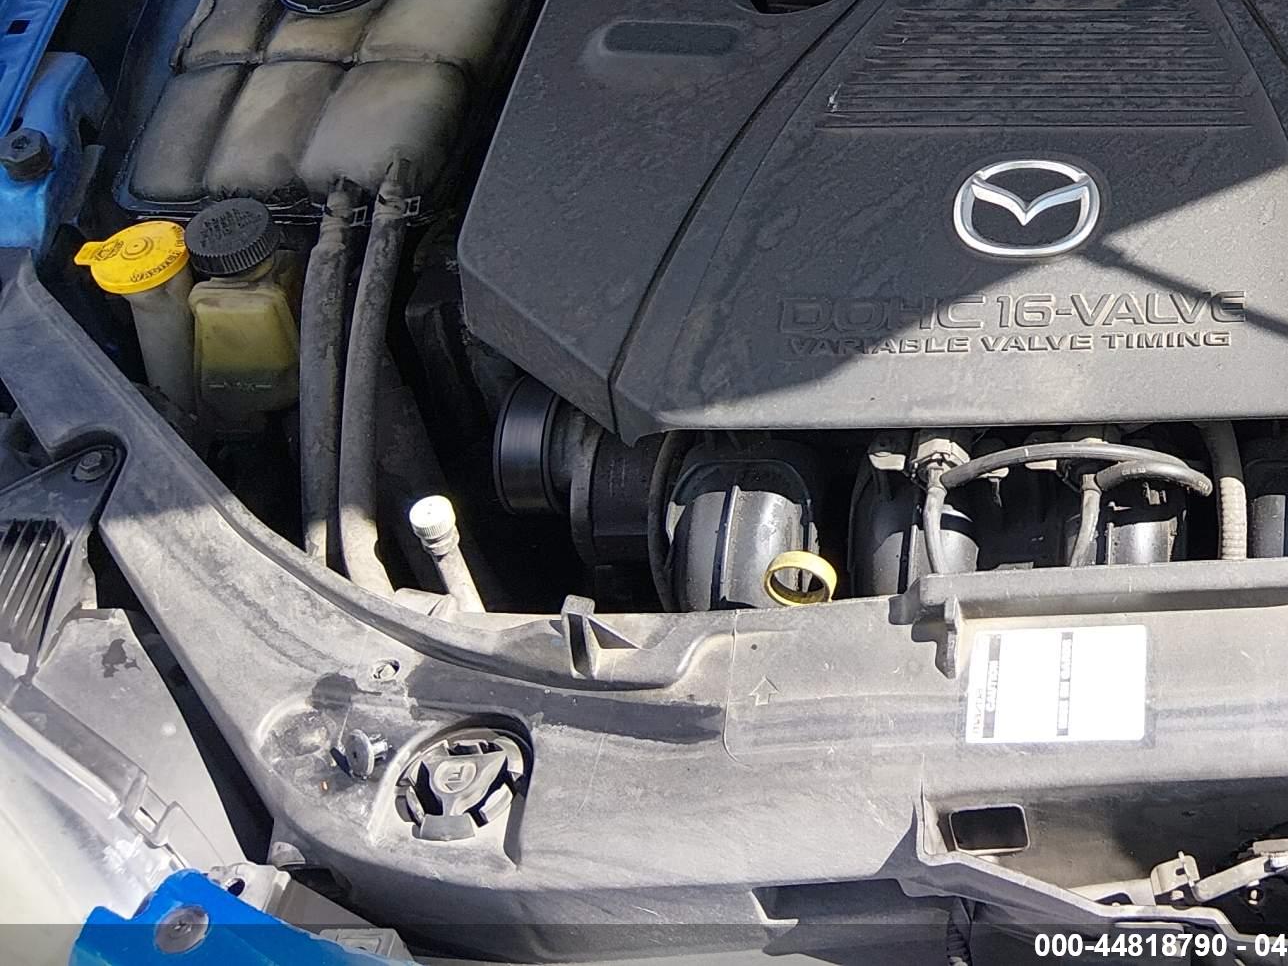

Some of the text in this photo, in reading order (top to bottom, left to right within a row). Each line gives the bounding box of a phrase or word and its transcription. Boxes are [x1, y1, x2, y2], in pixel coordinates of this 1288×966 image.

[779, 290, 1247, 334] DOHC 16-VALVE
[786, 330, 1232, 357] VARIABLE VALVE TIMING
